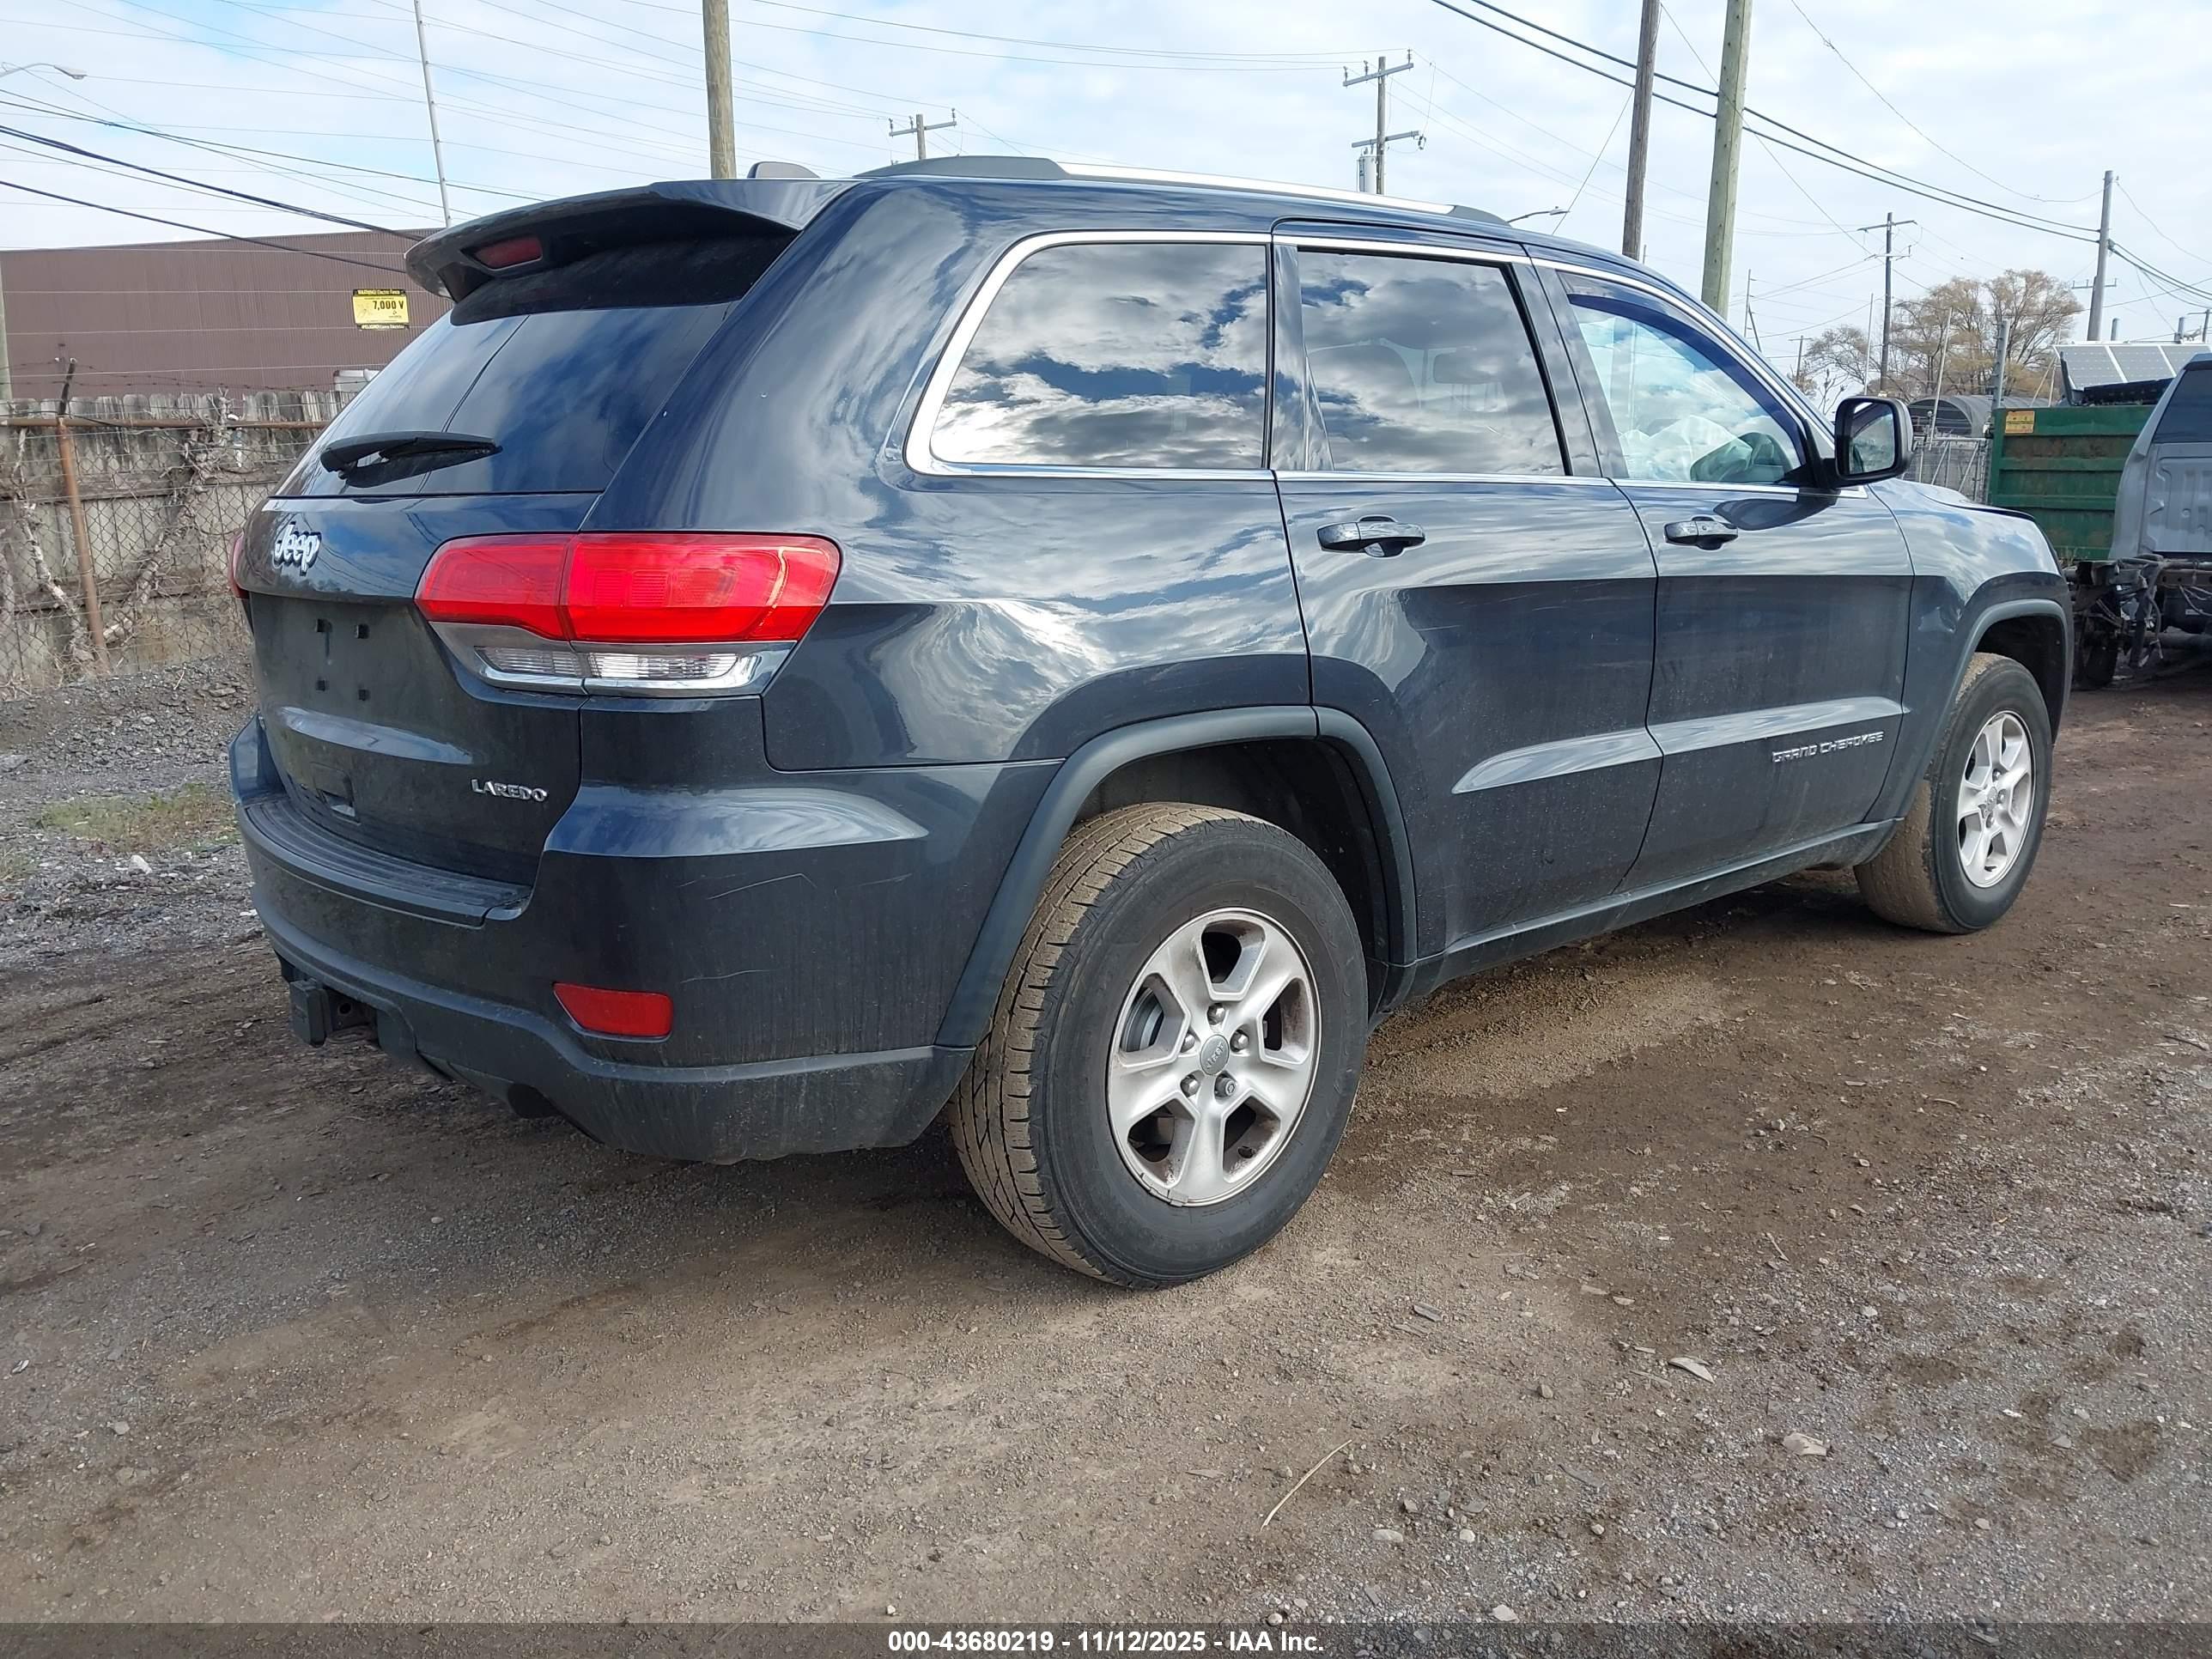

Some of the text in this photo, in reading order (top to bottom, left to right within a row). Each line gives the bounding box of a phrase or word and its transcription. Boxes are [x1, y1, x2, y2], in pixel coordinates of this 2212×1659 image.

[372, 301, 404, 310] 7,000 V
[274, 521, 321, 576] Jeep
[1771, 731, 1885, 763] GRAND CHEROKEE
[471, 778, 548, 802] LAREDO
